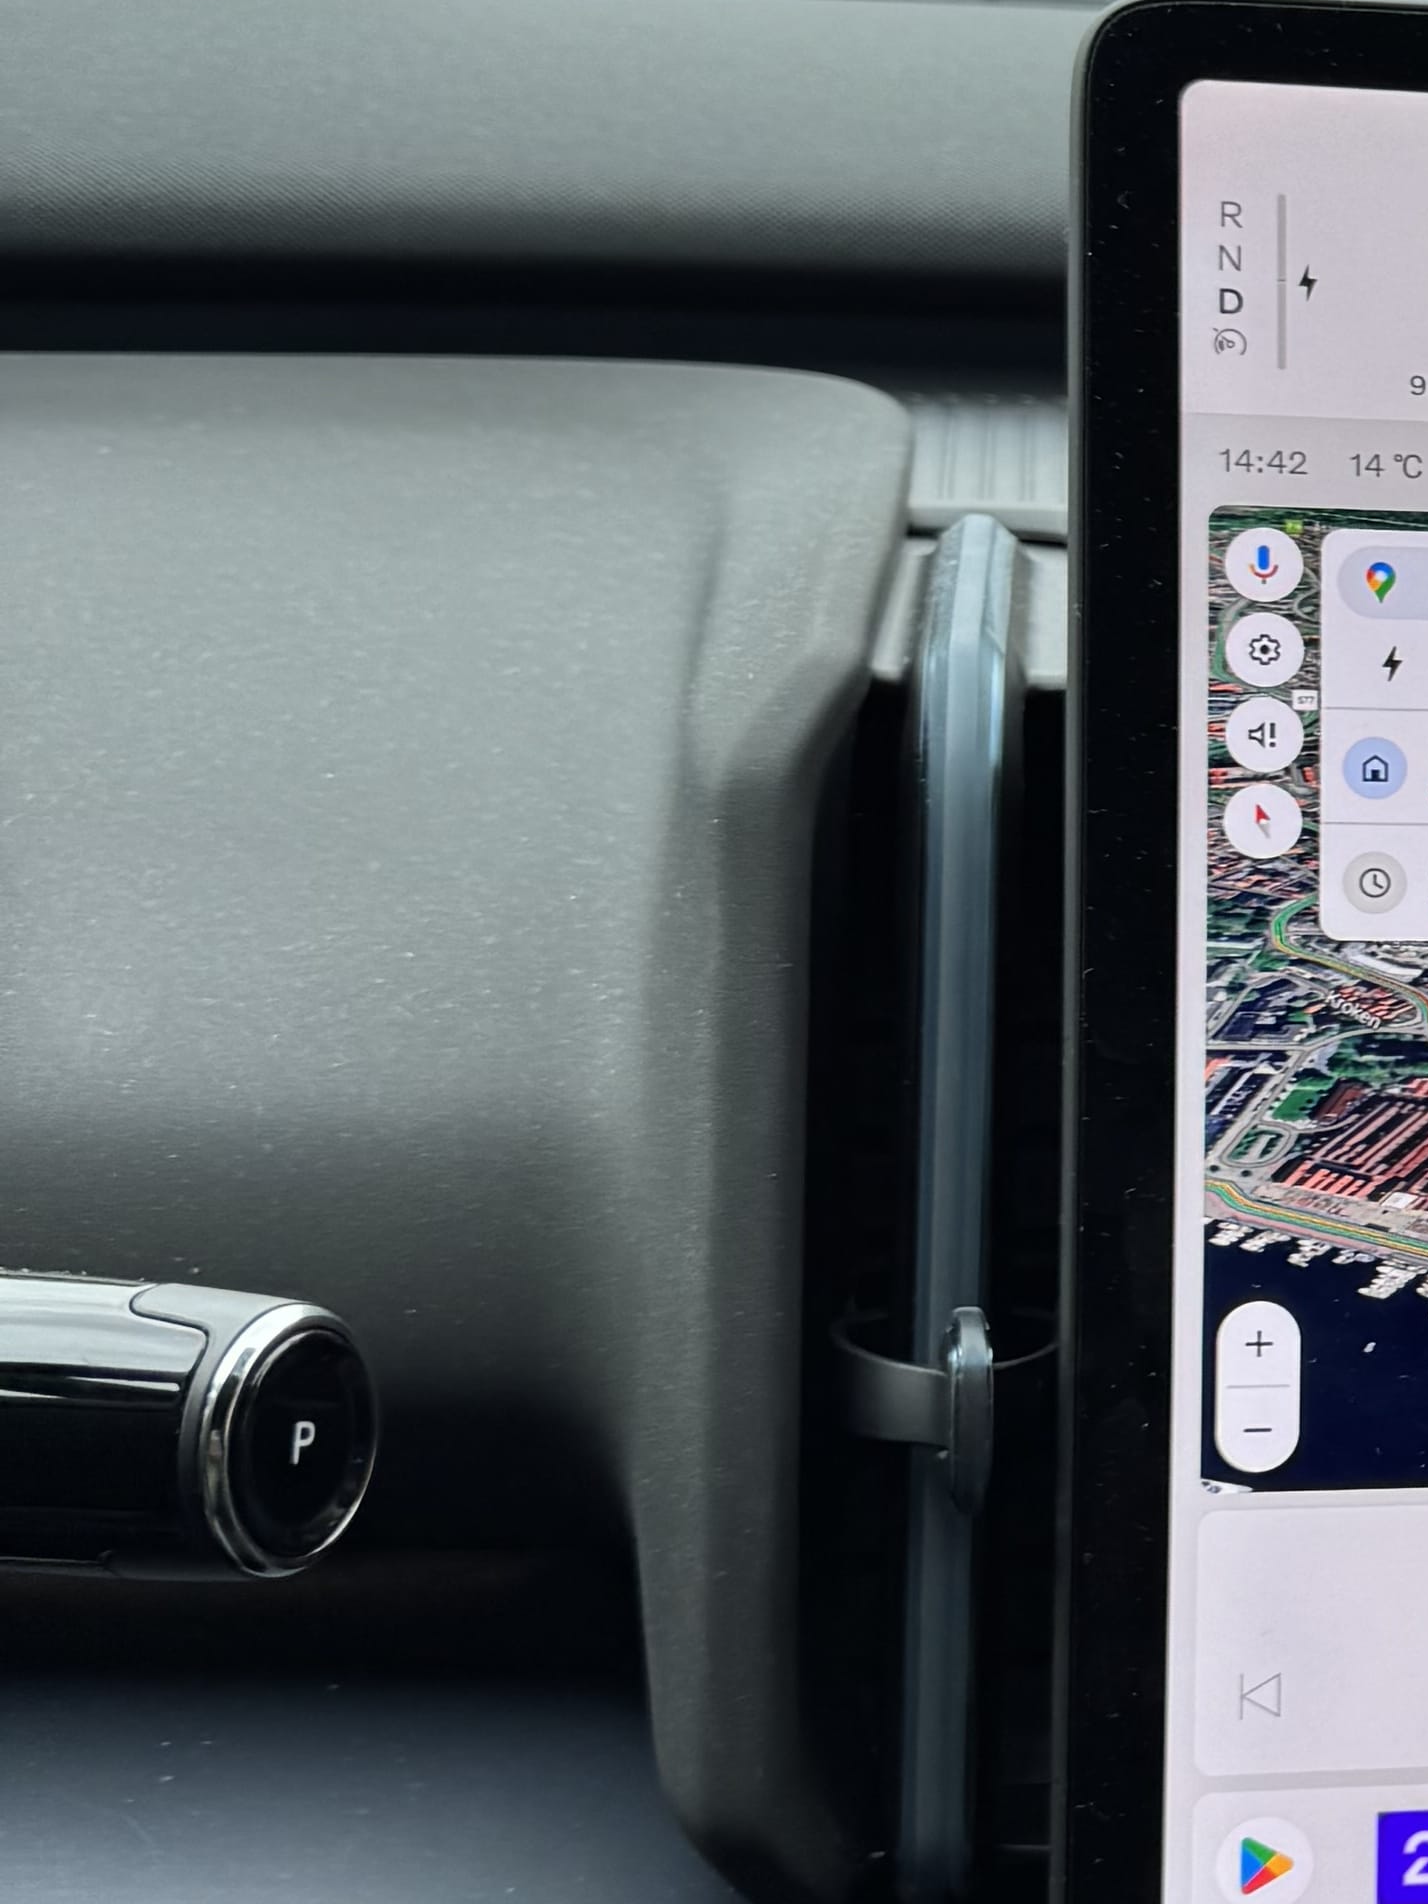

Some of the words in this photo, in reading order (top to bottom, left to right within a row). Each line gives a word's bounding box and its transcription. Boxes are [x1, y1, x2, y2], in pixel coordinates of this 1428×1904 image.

[1220, 200, 1243, 228] R
[1218, 244, 1242, 271] N
[1219, 287, 1244, 314] D
[1218, 447, 1309, 476] 14:42
[1348, 453, 1386, 478] 14
[290, 1419, 316, 1466] P
